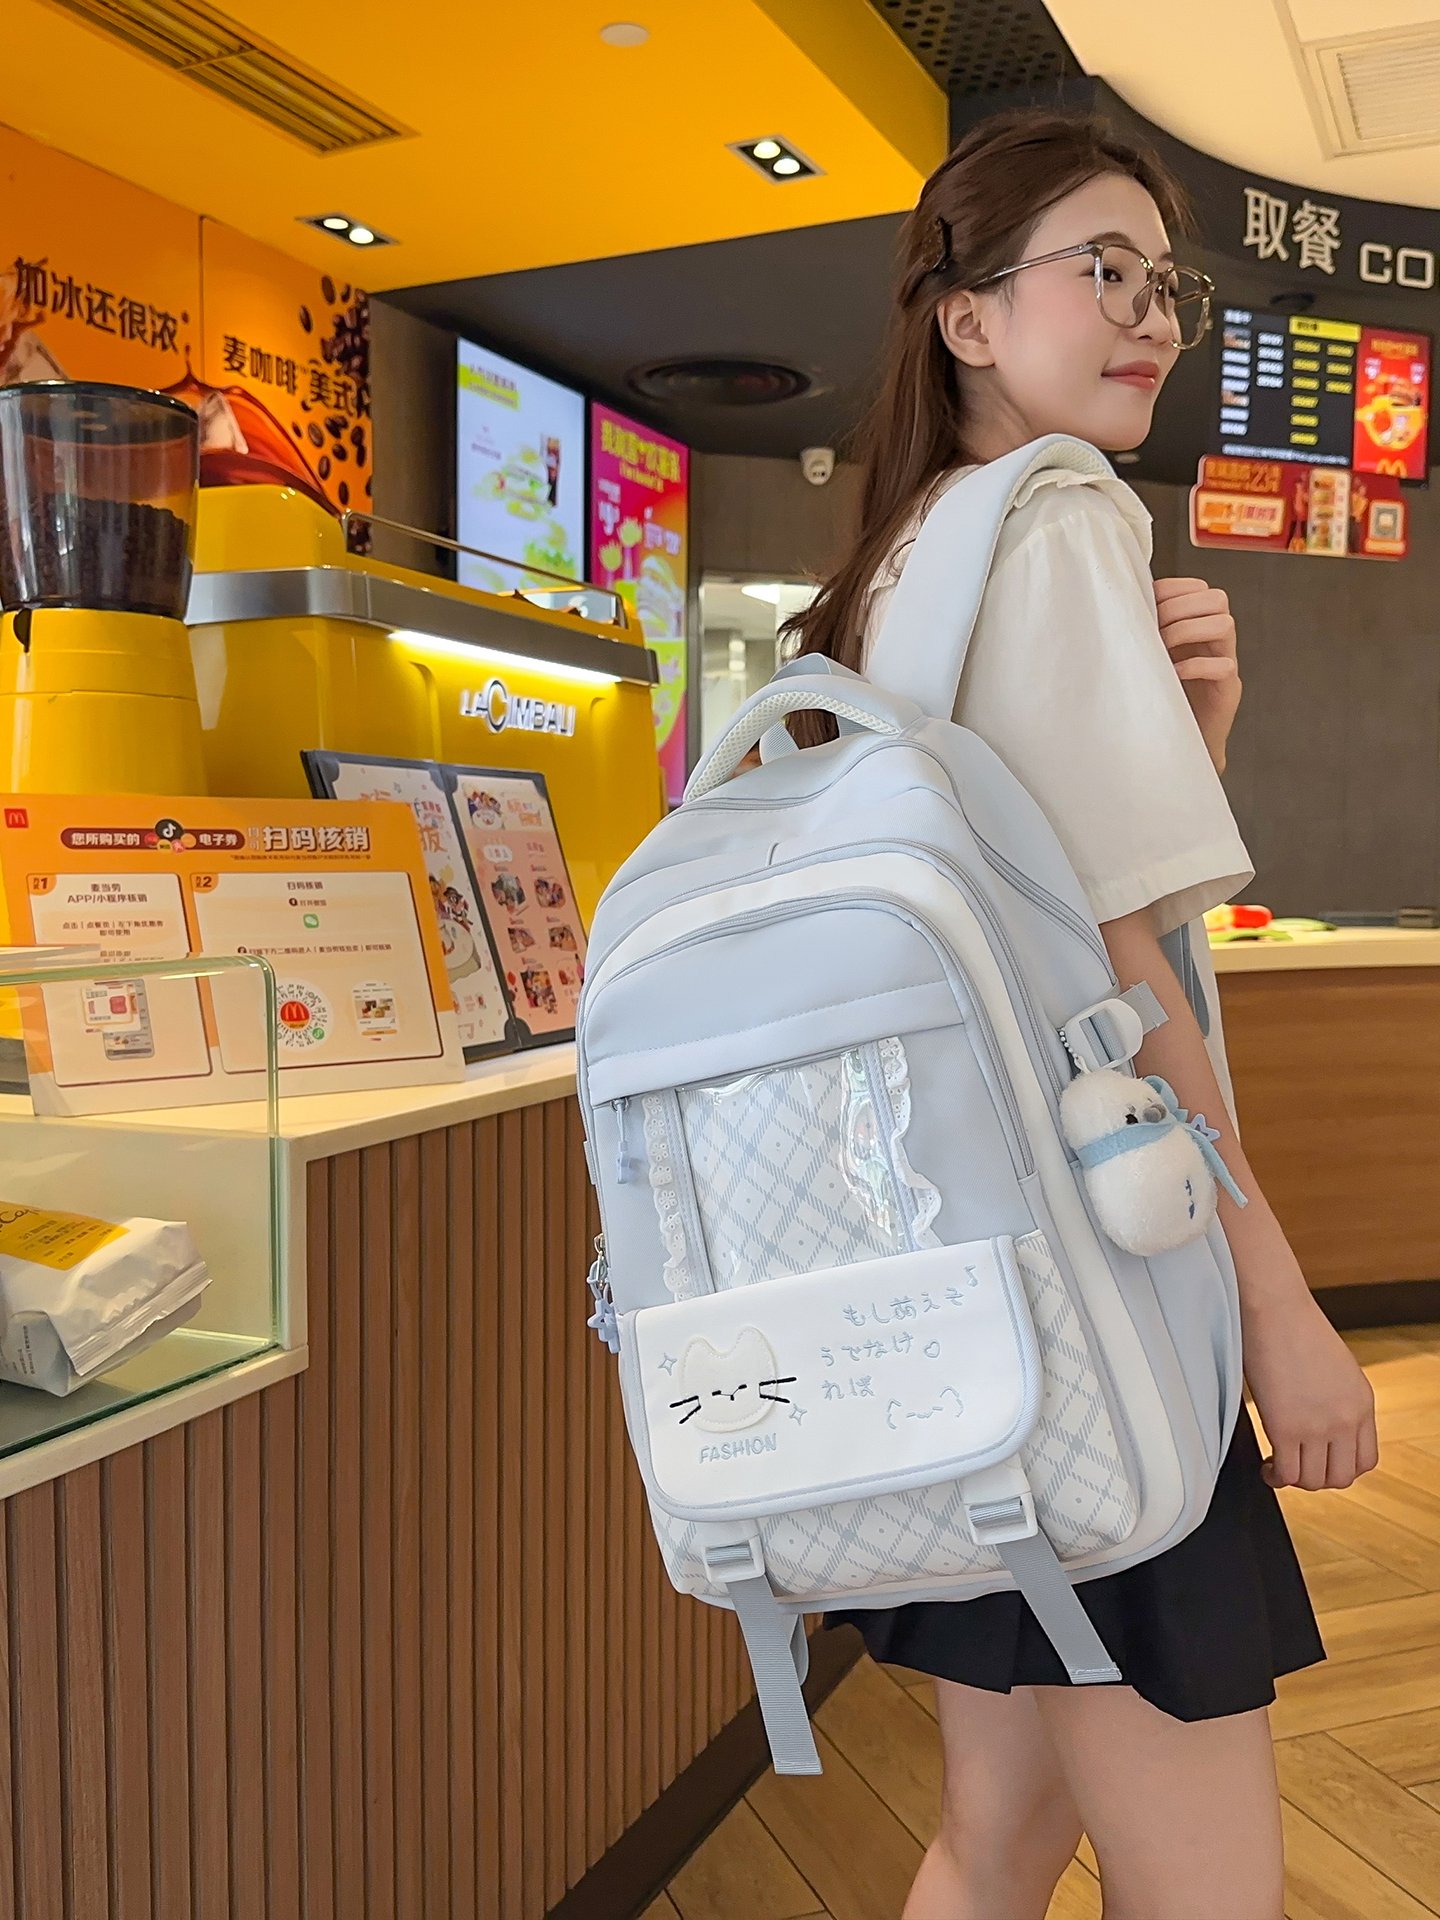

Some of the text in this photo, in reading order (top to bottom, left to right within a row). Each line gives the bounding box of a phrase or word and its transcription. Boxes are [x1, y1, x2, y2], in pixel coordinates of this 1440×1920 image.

[1243, 187, 1342, 276] 取餐
[14, 256, 179, 354] 加冰还很浓
[224, 335, 297, 395] 麦咖啡
[71, 832, 141, 847] 您所购买的
[199, 833, 238, 847] 电子券
[263, 826, 371, 852] 扫码核销
[91, 883, 121, 892] 麦当劳
[287, 881, 324, 890] 扫码核销
[699, 1432, 777, 1464] FASHION
